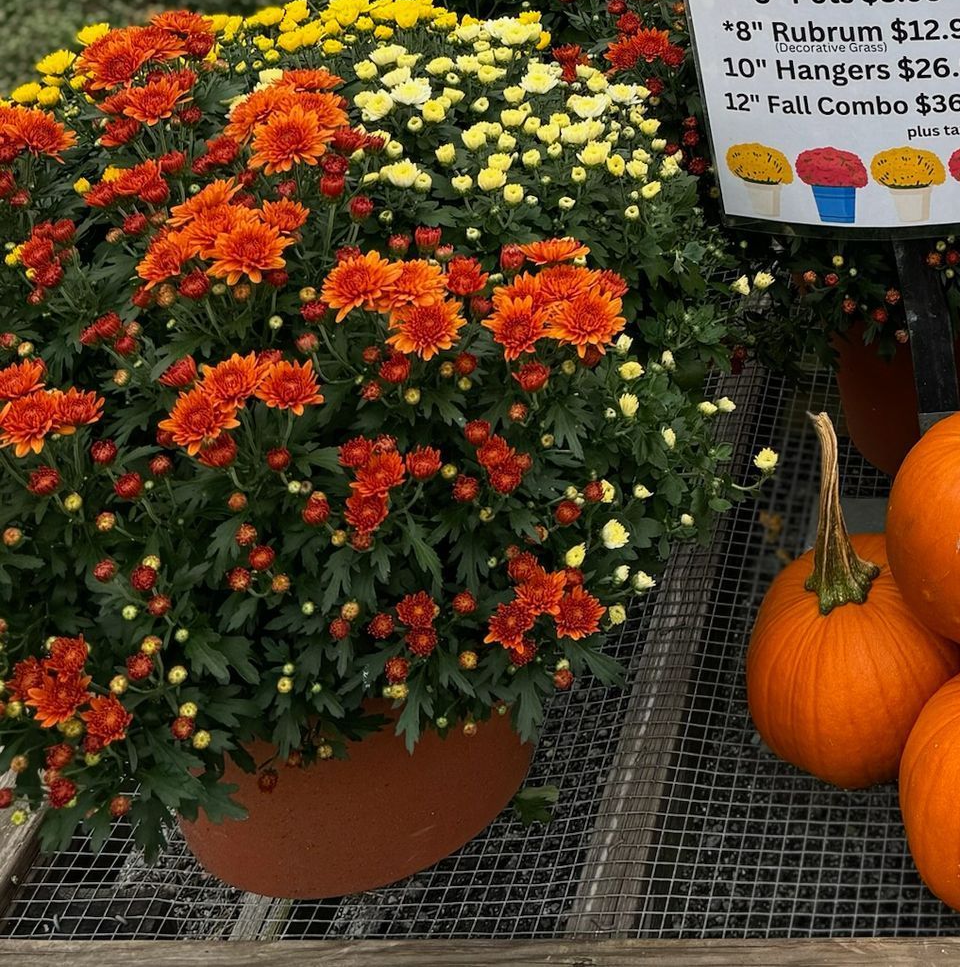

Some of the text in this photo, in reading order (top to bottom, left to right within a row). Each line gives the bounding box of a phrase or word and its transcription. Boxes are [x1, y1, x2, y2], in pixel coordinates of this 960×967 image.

[773, 21, 882, 42] Rubrum
[775, 42, 888, 54] (Decorative Grass)
[724, 58, 767, 79] 10"
[776, 59, 890, 85] Hangers
[725, 93, 760, 112] 12"
[769, 95, 811, 115] Fall
[818, 95, 908, 115] Combo
[907, 125, 940, 140] plus
